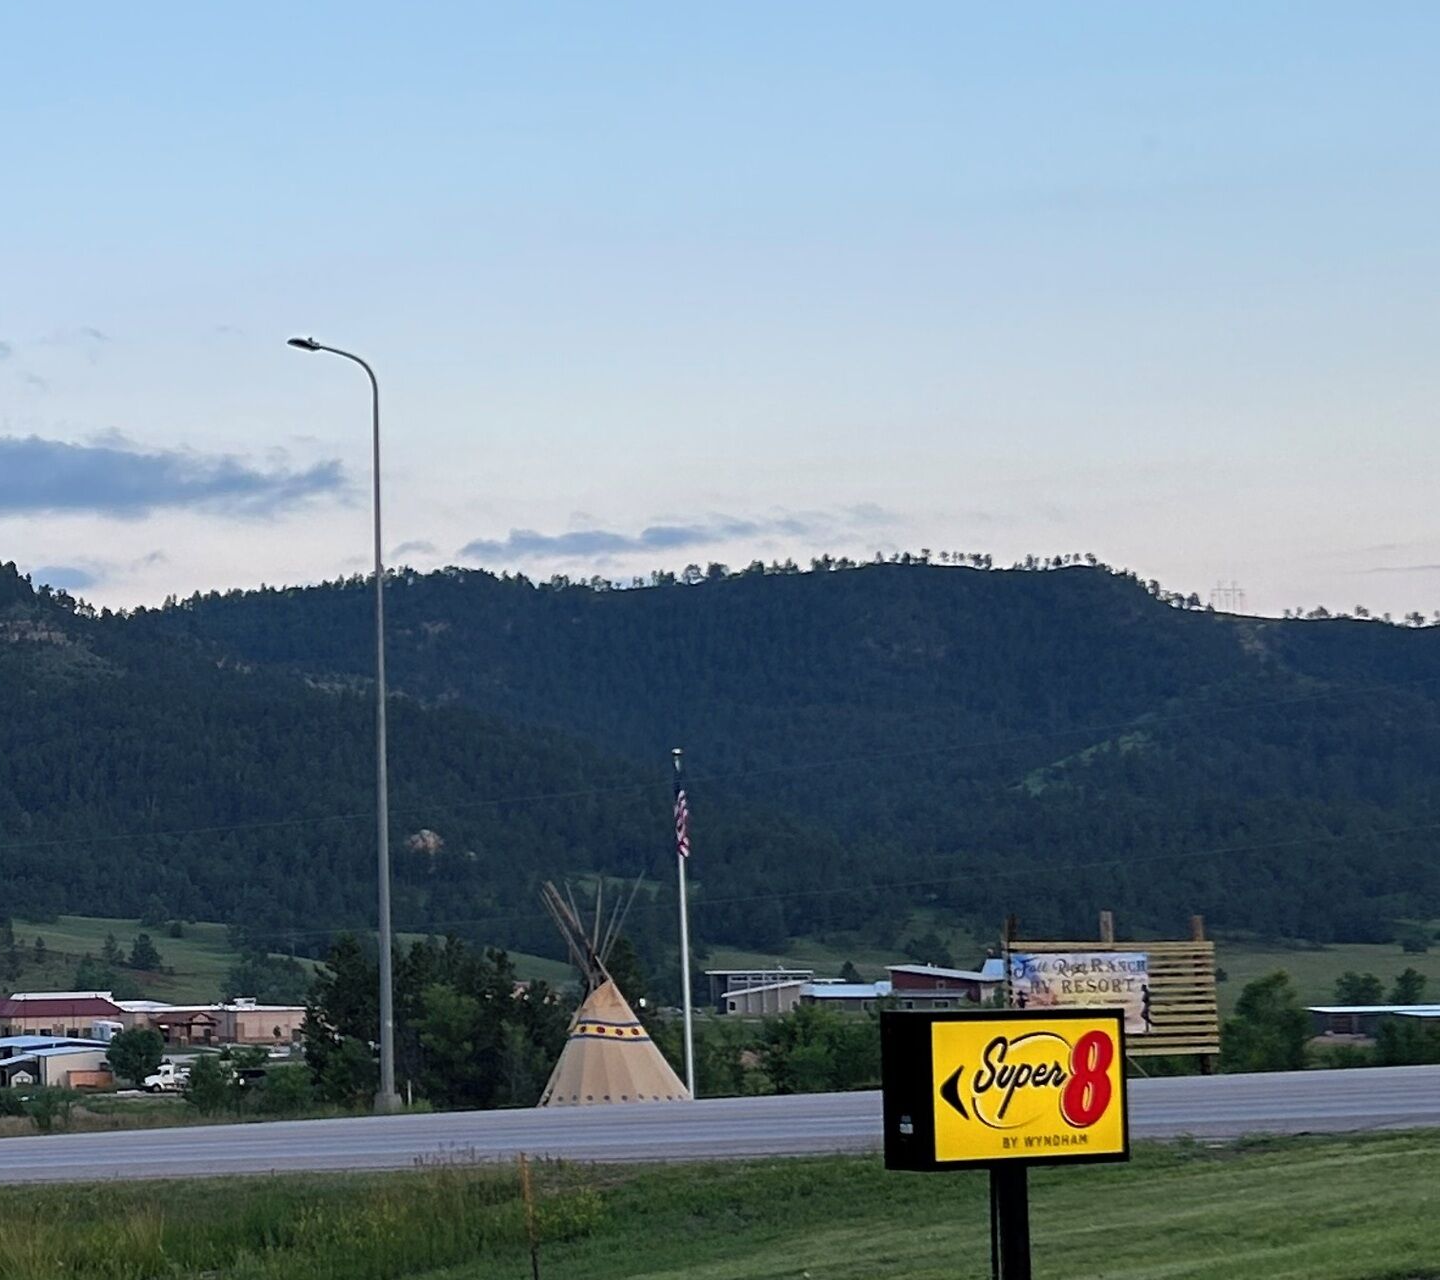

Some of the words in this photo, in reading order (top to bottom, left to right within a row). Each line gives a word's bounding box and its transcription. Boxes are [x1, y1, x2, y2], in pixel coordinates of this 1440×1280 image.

[1090, 957, 1146, 973] RANCH
[1061, 978, 1135, 994] RESORT
[972, 1036, 1068, 1120] Super
[1060, 1029, 1114, 1129] 8
[1002, 1136, 1018, 1149] BY
[1023, 1133, 1089, 1148] WYNDHAM
